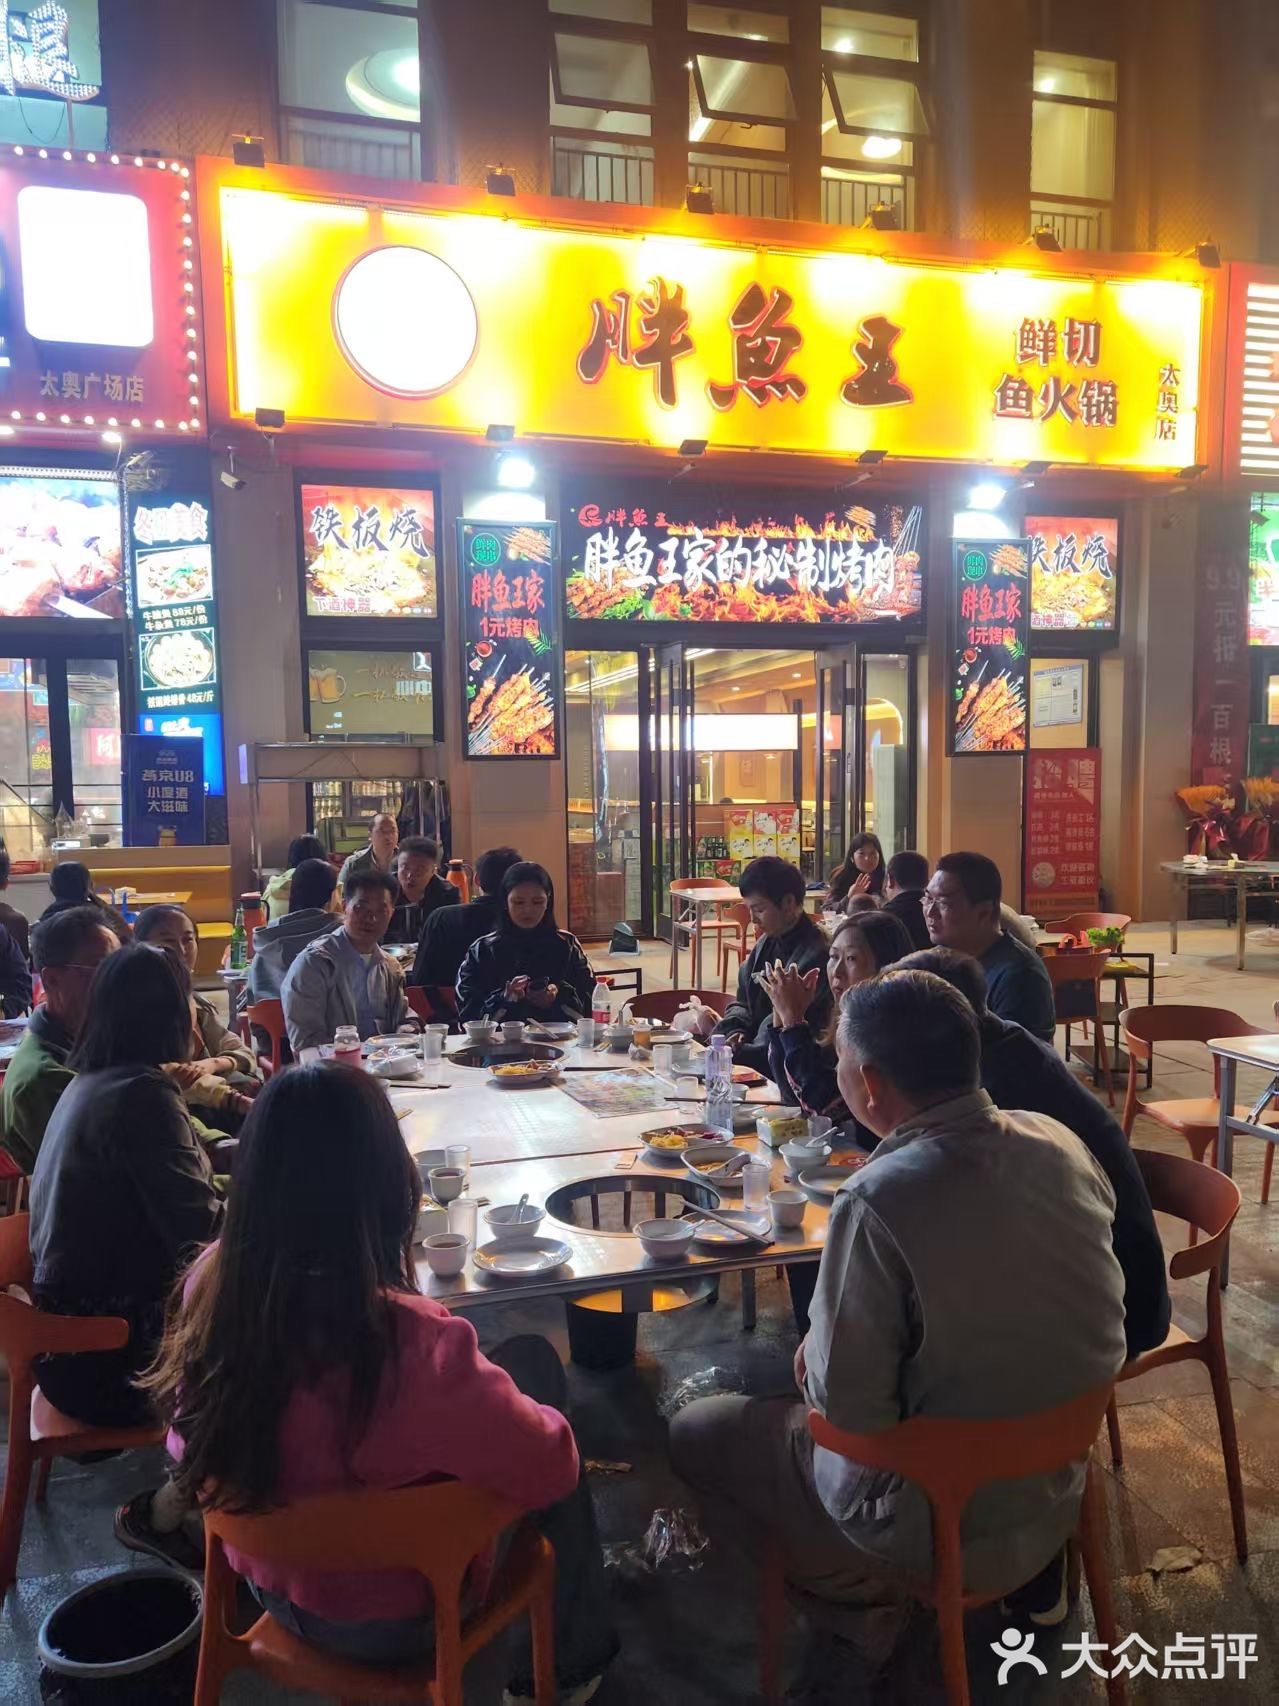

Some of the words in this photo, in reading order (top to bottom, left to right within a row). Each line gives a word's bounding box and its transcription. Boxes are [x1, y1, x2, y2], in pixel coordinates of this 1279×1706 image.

[1013, 317, 1103, 368] 鲜切
[39, 370, 145, 402] 太奥广场店
[992, 372, 1119, 428] 鱼火锅
[1154, 363, 1182, 441] 太奥店
[310, 504, 430, 559] 铁板烧
[584, 526, 897, 600] 胖鱼王家的秘制烤肉
[471, 568, 546, 614] 胖鱼王家
[961, 582, 1022, 624] 胖鱼王家
[480, 616, 540, 638] 1元烤肉
[967, 626, 1016, 646] 1元烤肉
[141, 769, 194, 783] 燕京U8
[147, 800, 189, 813] 大滋味
